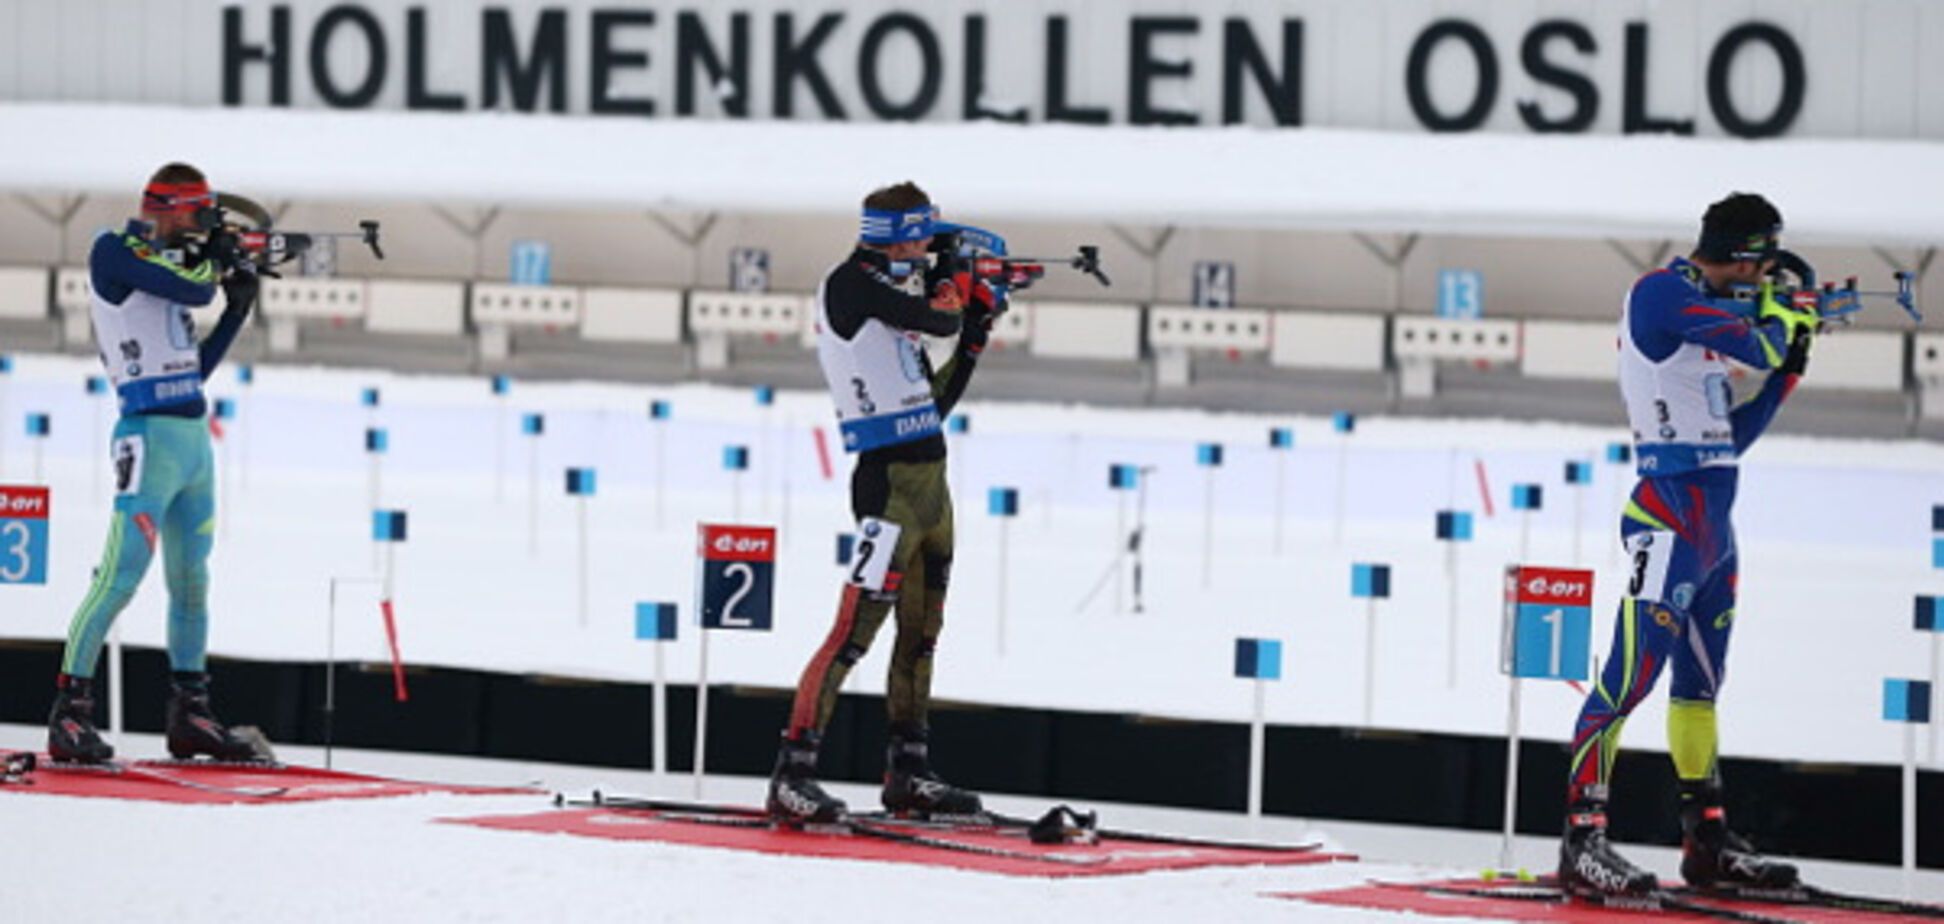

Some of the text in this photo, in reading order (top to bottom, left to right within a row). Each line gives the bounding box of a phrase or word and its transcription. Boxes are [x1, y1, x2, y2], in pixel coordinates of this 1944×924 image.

[222, 4, 1806, 139] HOLMENKOLLEN OSLO
[1443, 271, 1481, 316] 13
[1655, 398, 1671, 424] 3
[0, 521, 30, 580] 3
[852, 540, 875, 583] 2
[1629, 550, 1649, 596] 3
[720, 562, 754, 626] 2
[1542, 608, 1563, 676] 1
